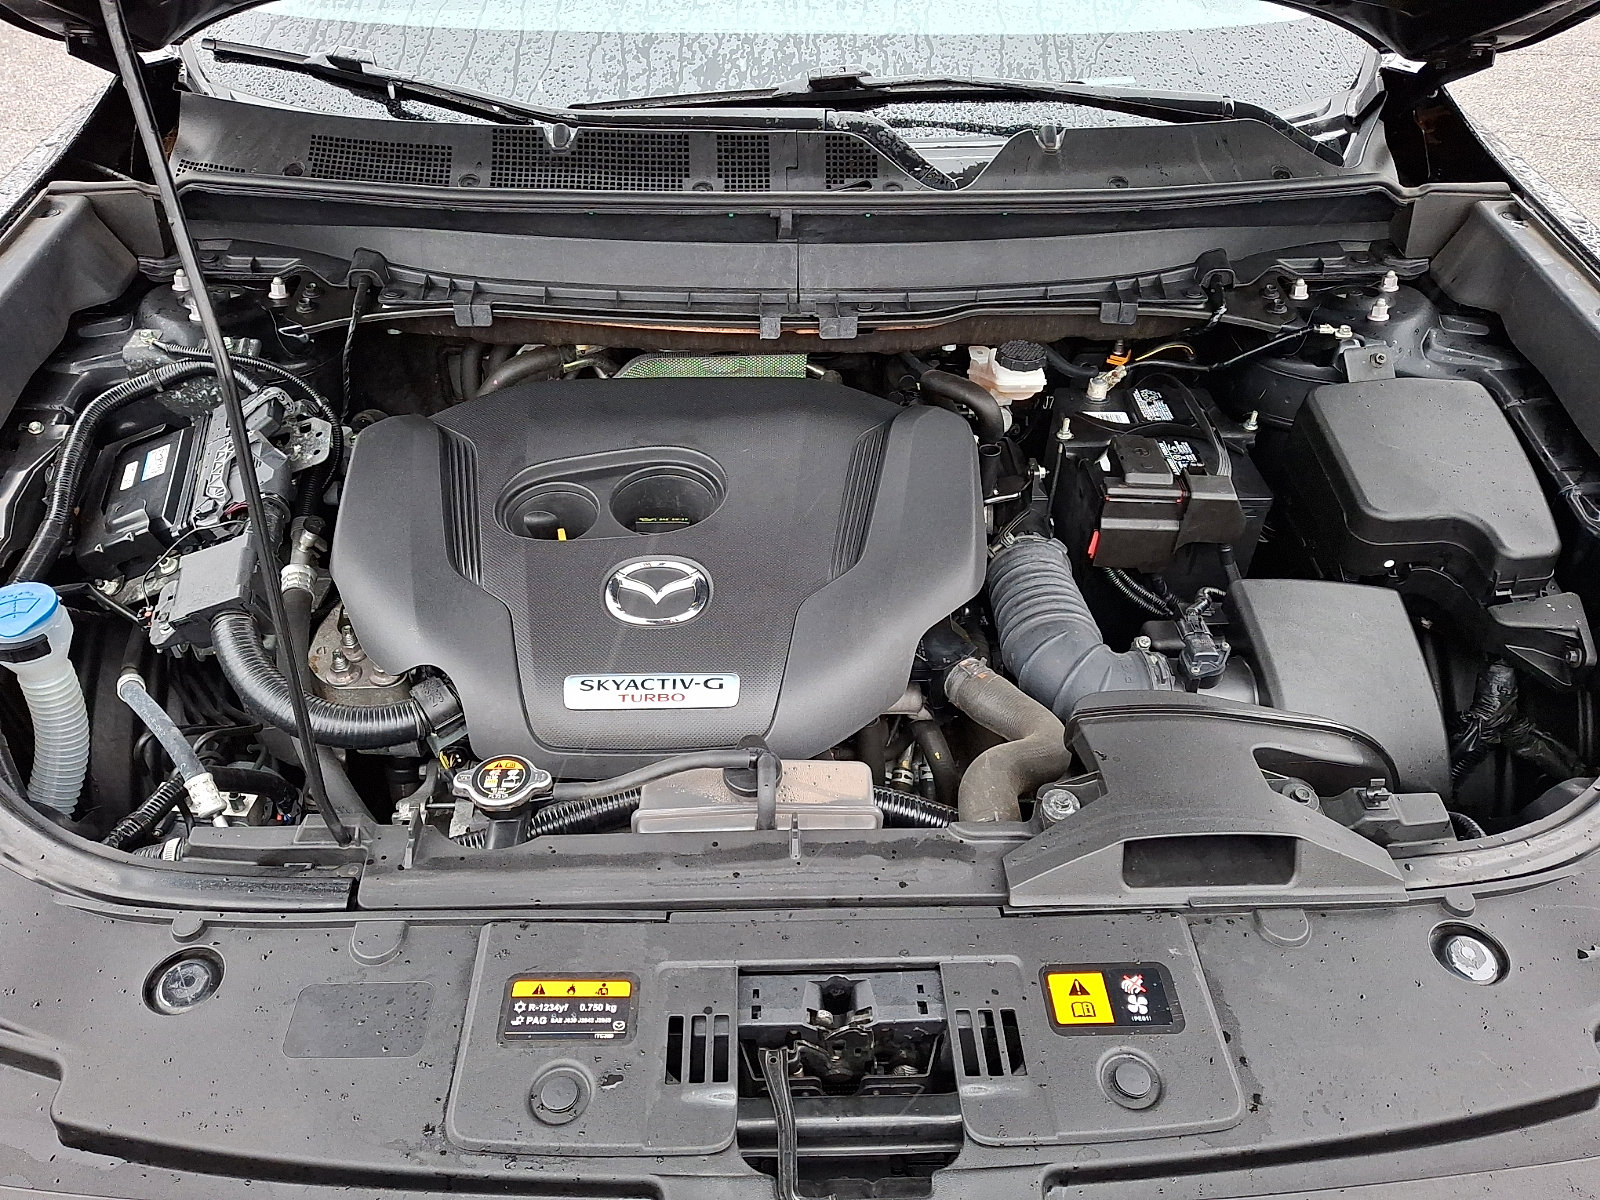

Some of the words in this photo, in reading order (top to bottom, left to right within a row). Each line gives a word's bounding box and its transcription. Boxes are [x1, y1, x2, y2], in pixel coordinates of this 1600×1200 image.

[579, 677, 724, 692] SKYACTIV-G
[618, 693, 686, 703] TURBO
[528, 1003, 569, 1013] R-1234yf
[579, 1003, 603, 1012] 0.750
[605, 1003, 618, 1013] kg
[525, 1016, 547, 1025] PAG
